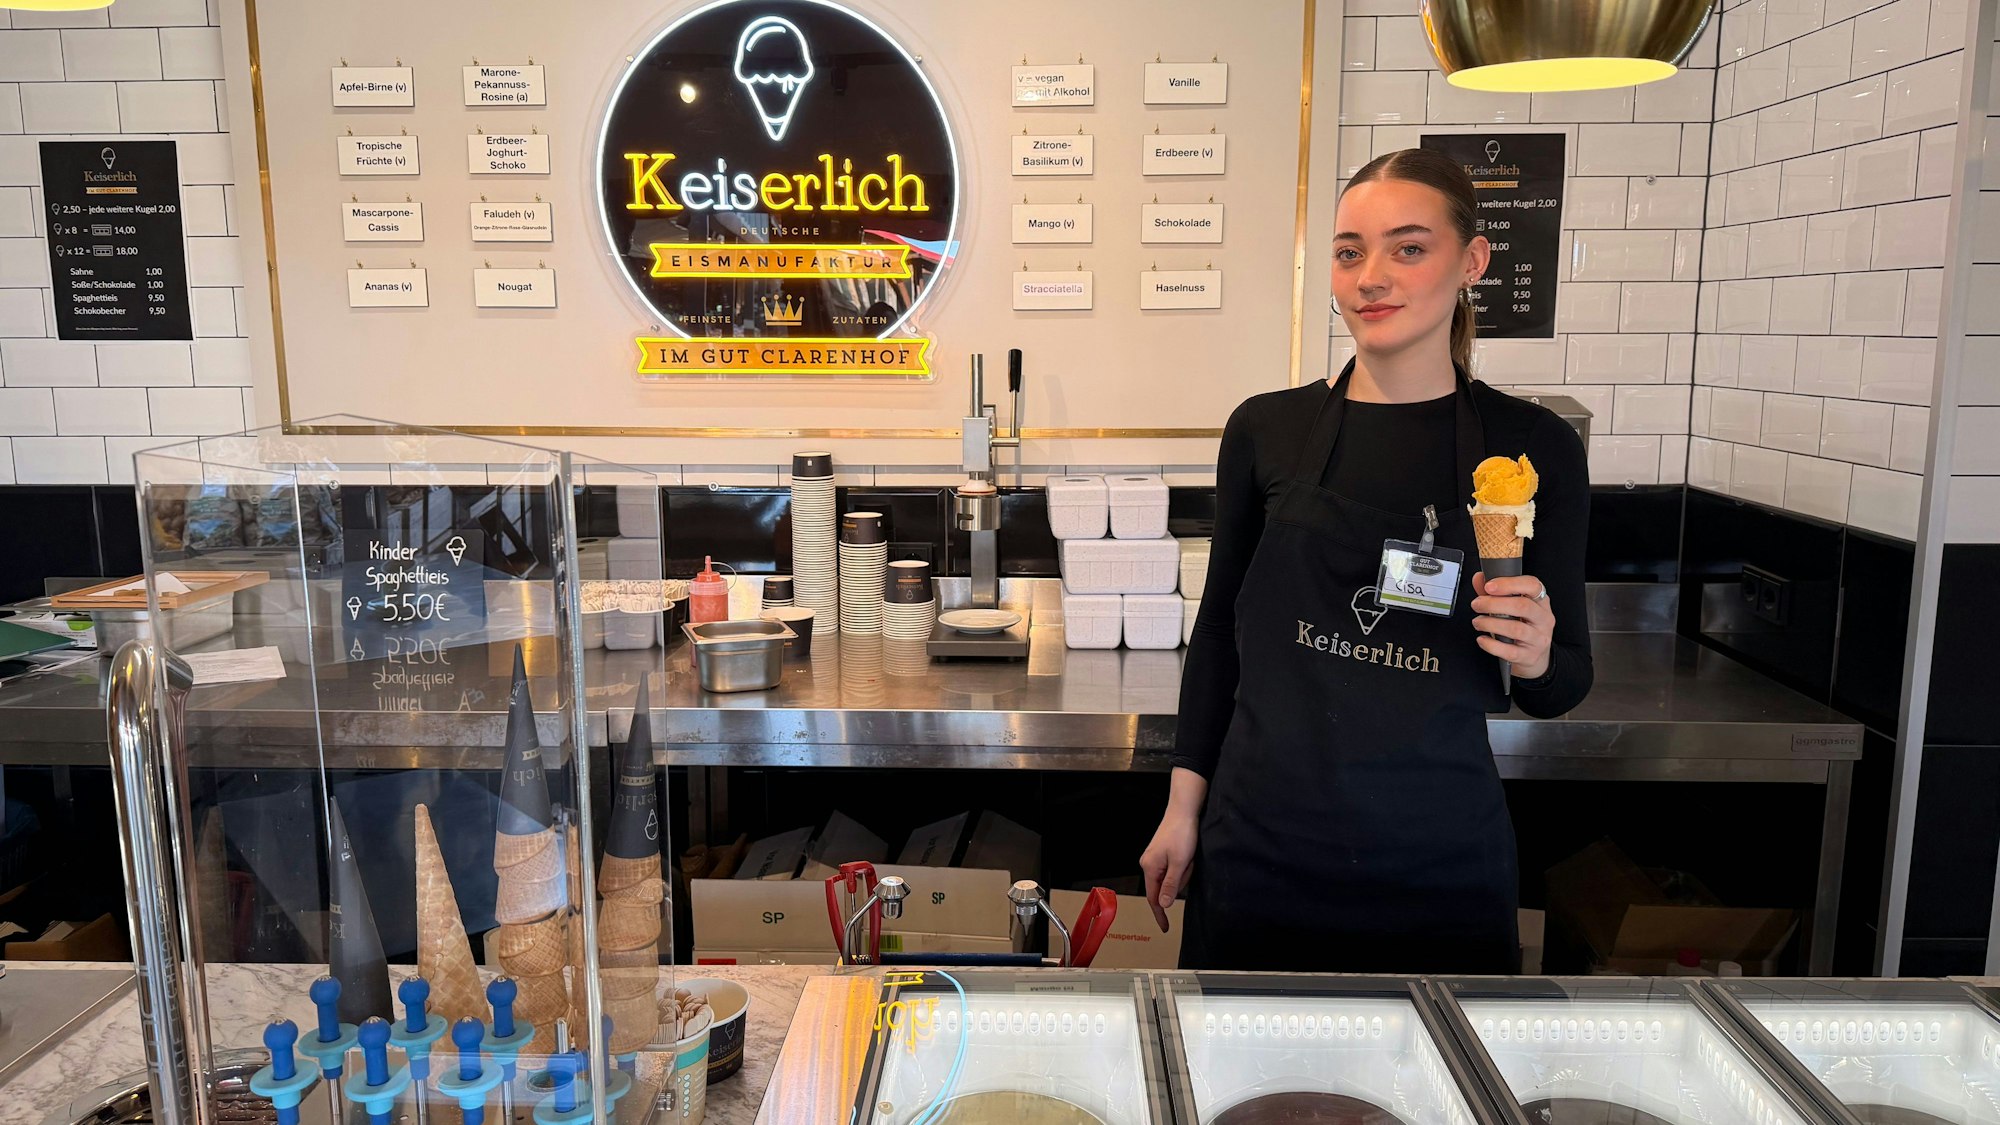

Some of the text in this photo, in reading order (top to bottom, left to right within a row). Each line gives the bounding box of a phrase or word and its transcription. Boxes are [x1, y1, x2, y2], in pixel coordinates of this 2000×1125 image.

[1035, 76, 1064, 84] vegan
[1169, 78, 1200, 86] Vanille
[340, 83, 406, 92] Apfel-Birne (v)
[1054, 87, 1089, 96] Alkohol
[482, 93, 527, 102] Rosine (a)
[357, 142, 402, 151] Tropische
[1033, 141, 1071, 149] Zitrone-
[487, 149, 527, 158] Joghurt-
[1156, 148, 1213, 158] Erdbeere (v)
[357, 156, 405, 166] Früchte (v)
[491, 161, 525, 169] Schoko
[1023, 157, 1083, 166] Basilikum (v)
[1464, 164, 1520, 175] Keiserlich
[84, 171, 136, 181] Keiserlich
[624, 152, 930, 212] Keiserlich
[1481, 200, 1511, 208] weitere
[1514, 200, 1536, 209] Kugel
[1538, 199, 1556, 207] 2,00
[63, 206, 80, 214] 2,50
[89, 206, 105, 214] jede
[135, 205, 157, 214] Kugel
[159, 205, 175, 213] 2,00
[353, 209, 413, 218] Mascarpone-
[484, 210, 534, 220] Faludeh (v)
[1029, 220, 1074, 229] Mango (v)
[1155, 219, 1211, 227] Schokolade
[1488, 221, 1510, 230] 14,00
[115, 226, 136, 234] 14,00
[740, 226, 820, 236] DEUTSCHE
[74, 247, 84, 255] 12
[116, 247, 138, 255] 18,00
[671, 255, 893, 268] EISMANUFAKTUR
[146, 268, 162, 276] 1,00
[1515, 264, 1532, 272] 1,00
[148, 281, 163, 289] 1,00
[1515, 277, 1531, 285] 1,00
[402, 282, 412, 291] (v)
[498, 283, 532, 292] Nougat
[1024, 285, 1082, 293] Stracciatella
[73, 294, 164, 303] Spaghettieis 9,50
[1513, 291, 1530, 299] 9,50
[149, 307, 165, 315] 9,50
[1513, 304, 1530, 312] 9,50
[683, 315, 887, 324] FEINSTE ZUTATEN
[660, 349, 911, 365] IM GUT CLARENHOF
[369, 540, 419, 561] Kinder
[365, 565, 450, 593] Spaghettieis
[383, 593, 451, 622] 5,50€
[1296, 620, 1440, 673] Keiserlich
[932, 892, 945, 904] SP
[763, 912, 784, 923] SP
